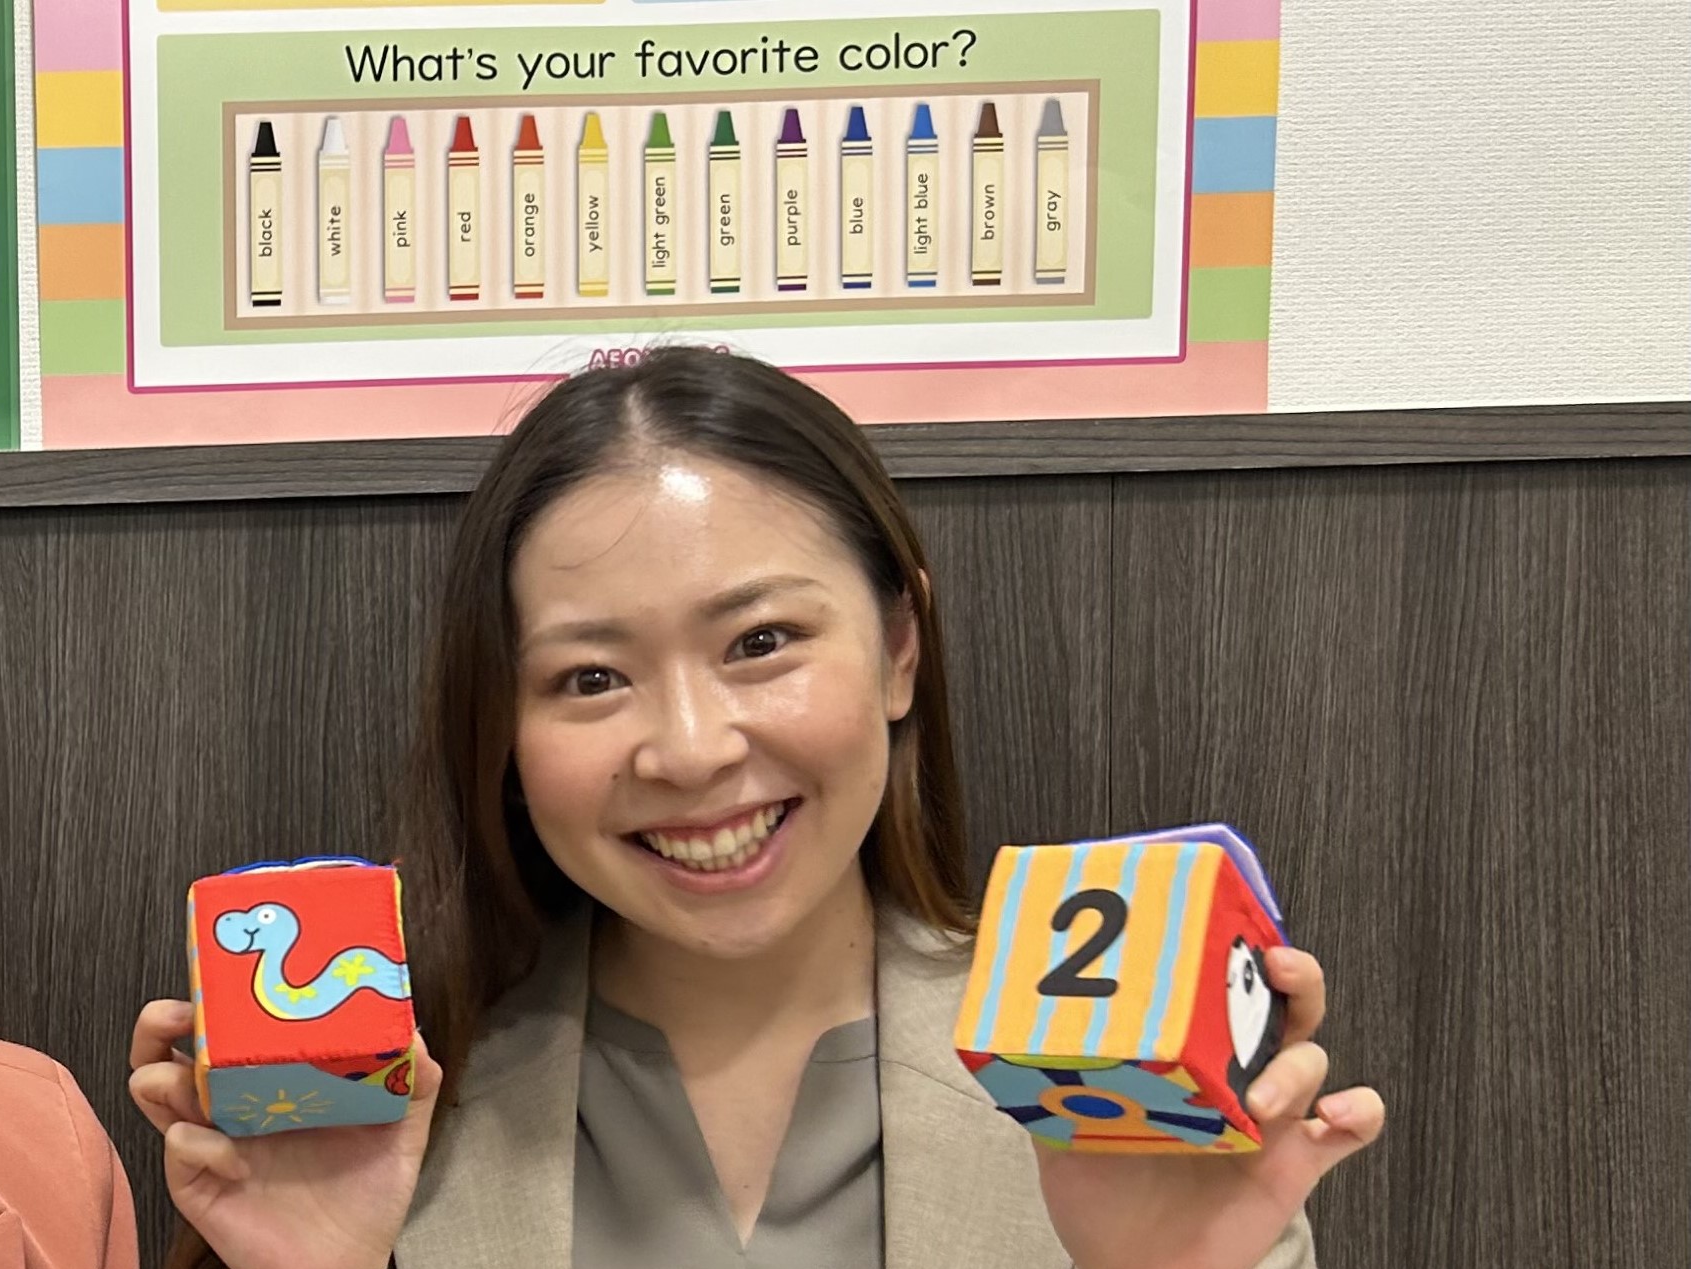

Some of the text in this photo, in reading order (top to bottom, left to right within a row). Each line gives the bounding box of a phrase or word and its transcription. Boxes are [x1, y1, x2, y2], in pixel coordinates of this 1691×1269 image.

[345, 29, 977, 89] What's your favorite color?
[258, 208, 272, 257] black
[328, 205, 342, 256] white
[394, 210, 412, 248] pink
[459, 211, 472, 242] red
[524, 193, 542, 257] orange
[586, 195, 603, 253] yellow
[652, 176, 670, 269] light green
[721, 193, 735, 246] green
[784, 188, 802, 247] purple
[849, 196, 864, 234] blue
[914, 173, 929, 256] light blue
[981, 183, 995, 241] brown
[1046, 189, 1062, 232] gray
[588, 348, 650, 370] AEO
[1037, 888, 1129, 997] 2
